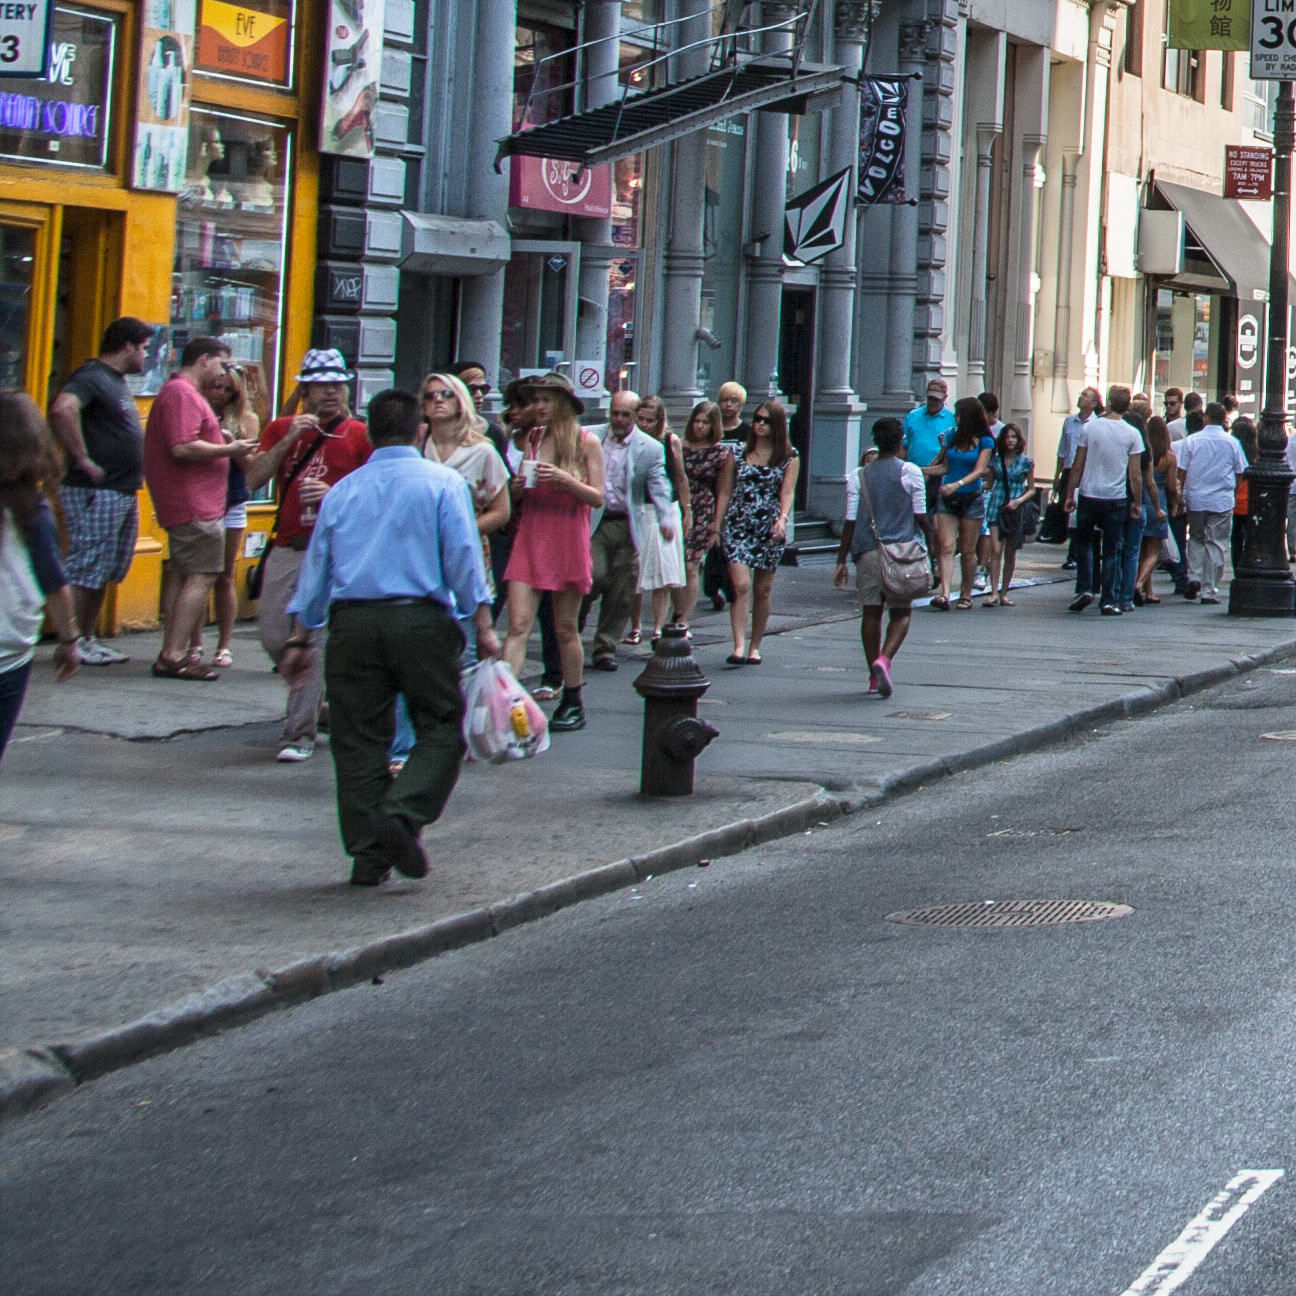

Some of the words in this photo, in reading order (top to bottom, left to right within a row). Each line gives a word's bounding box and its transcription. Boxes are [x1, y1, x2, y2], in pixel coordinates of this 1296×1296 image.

[236, 12, 256, 40] EVE
[1254, 53, 1280, 62] SPEED
[1265, 62, 1276, 72] BY
[1228, 150, 1238, 159] NO
